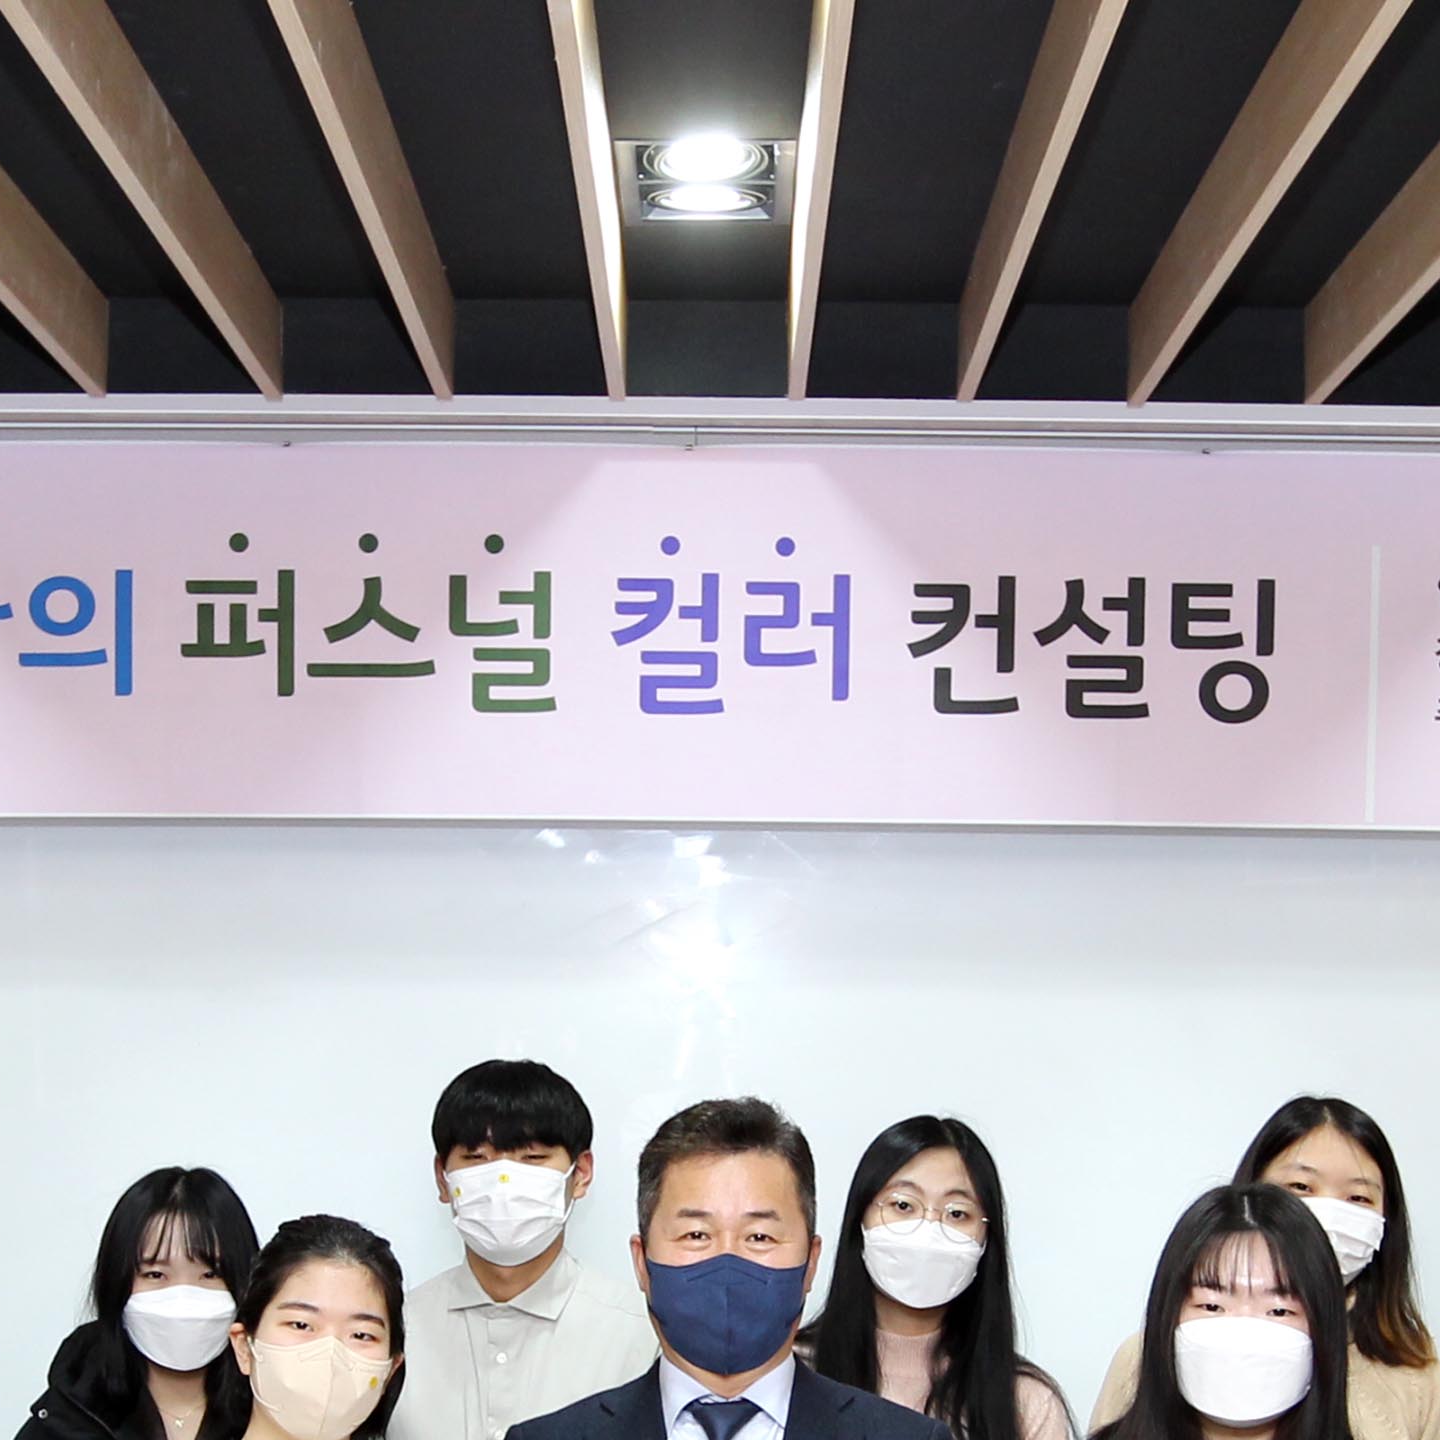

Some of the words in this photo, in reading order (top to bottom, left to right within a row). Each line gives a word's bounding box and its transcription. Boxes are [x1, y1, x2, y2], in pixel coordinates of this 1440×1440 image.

[181, 533, 557, 713] 퍼스널
[611, 536, 850, 715] 컬러
[907, 576, 1275, 724] 컨설팅
